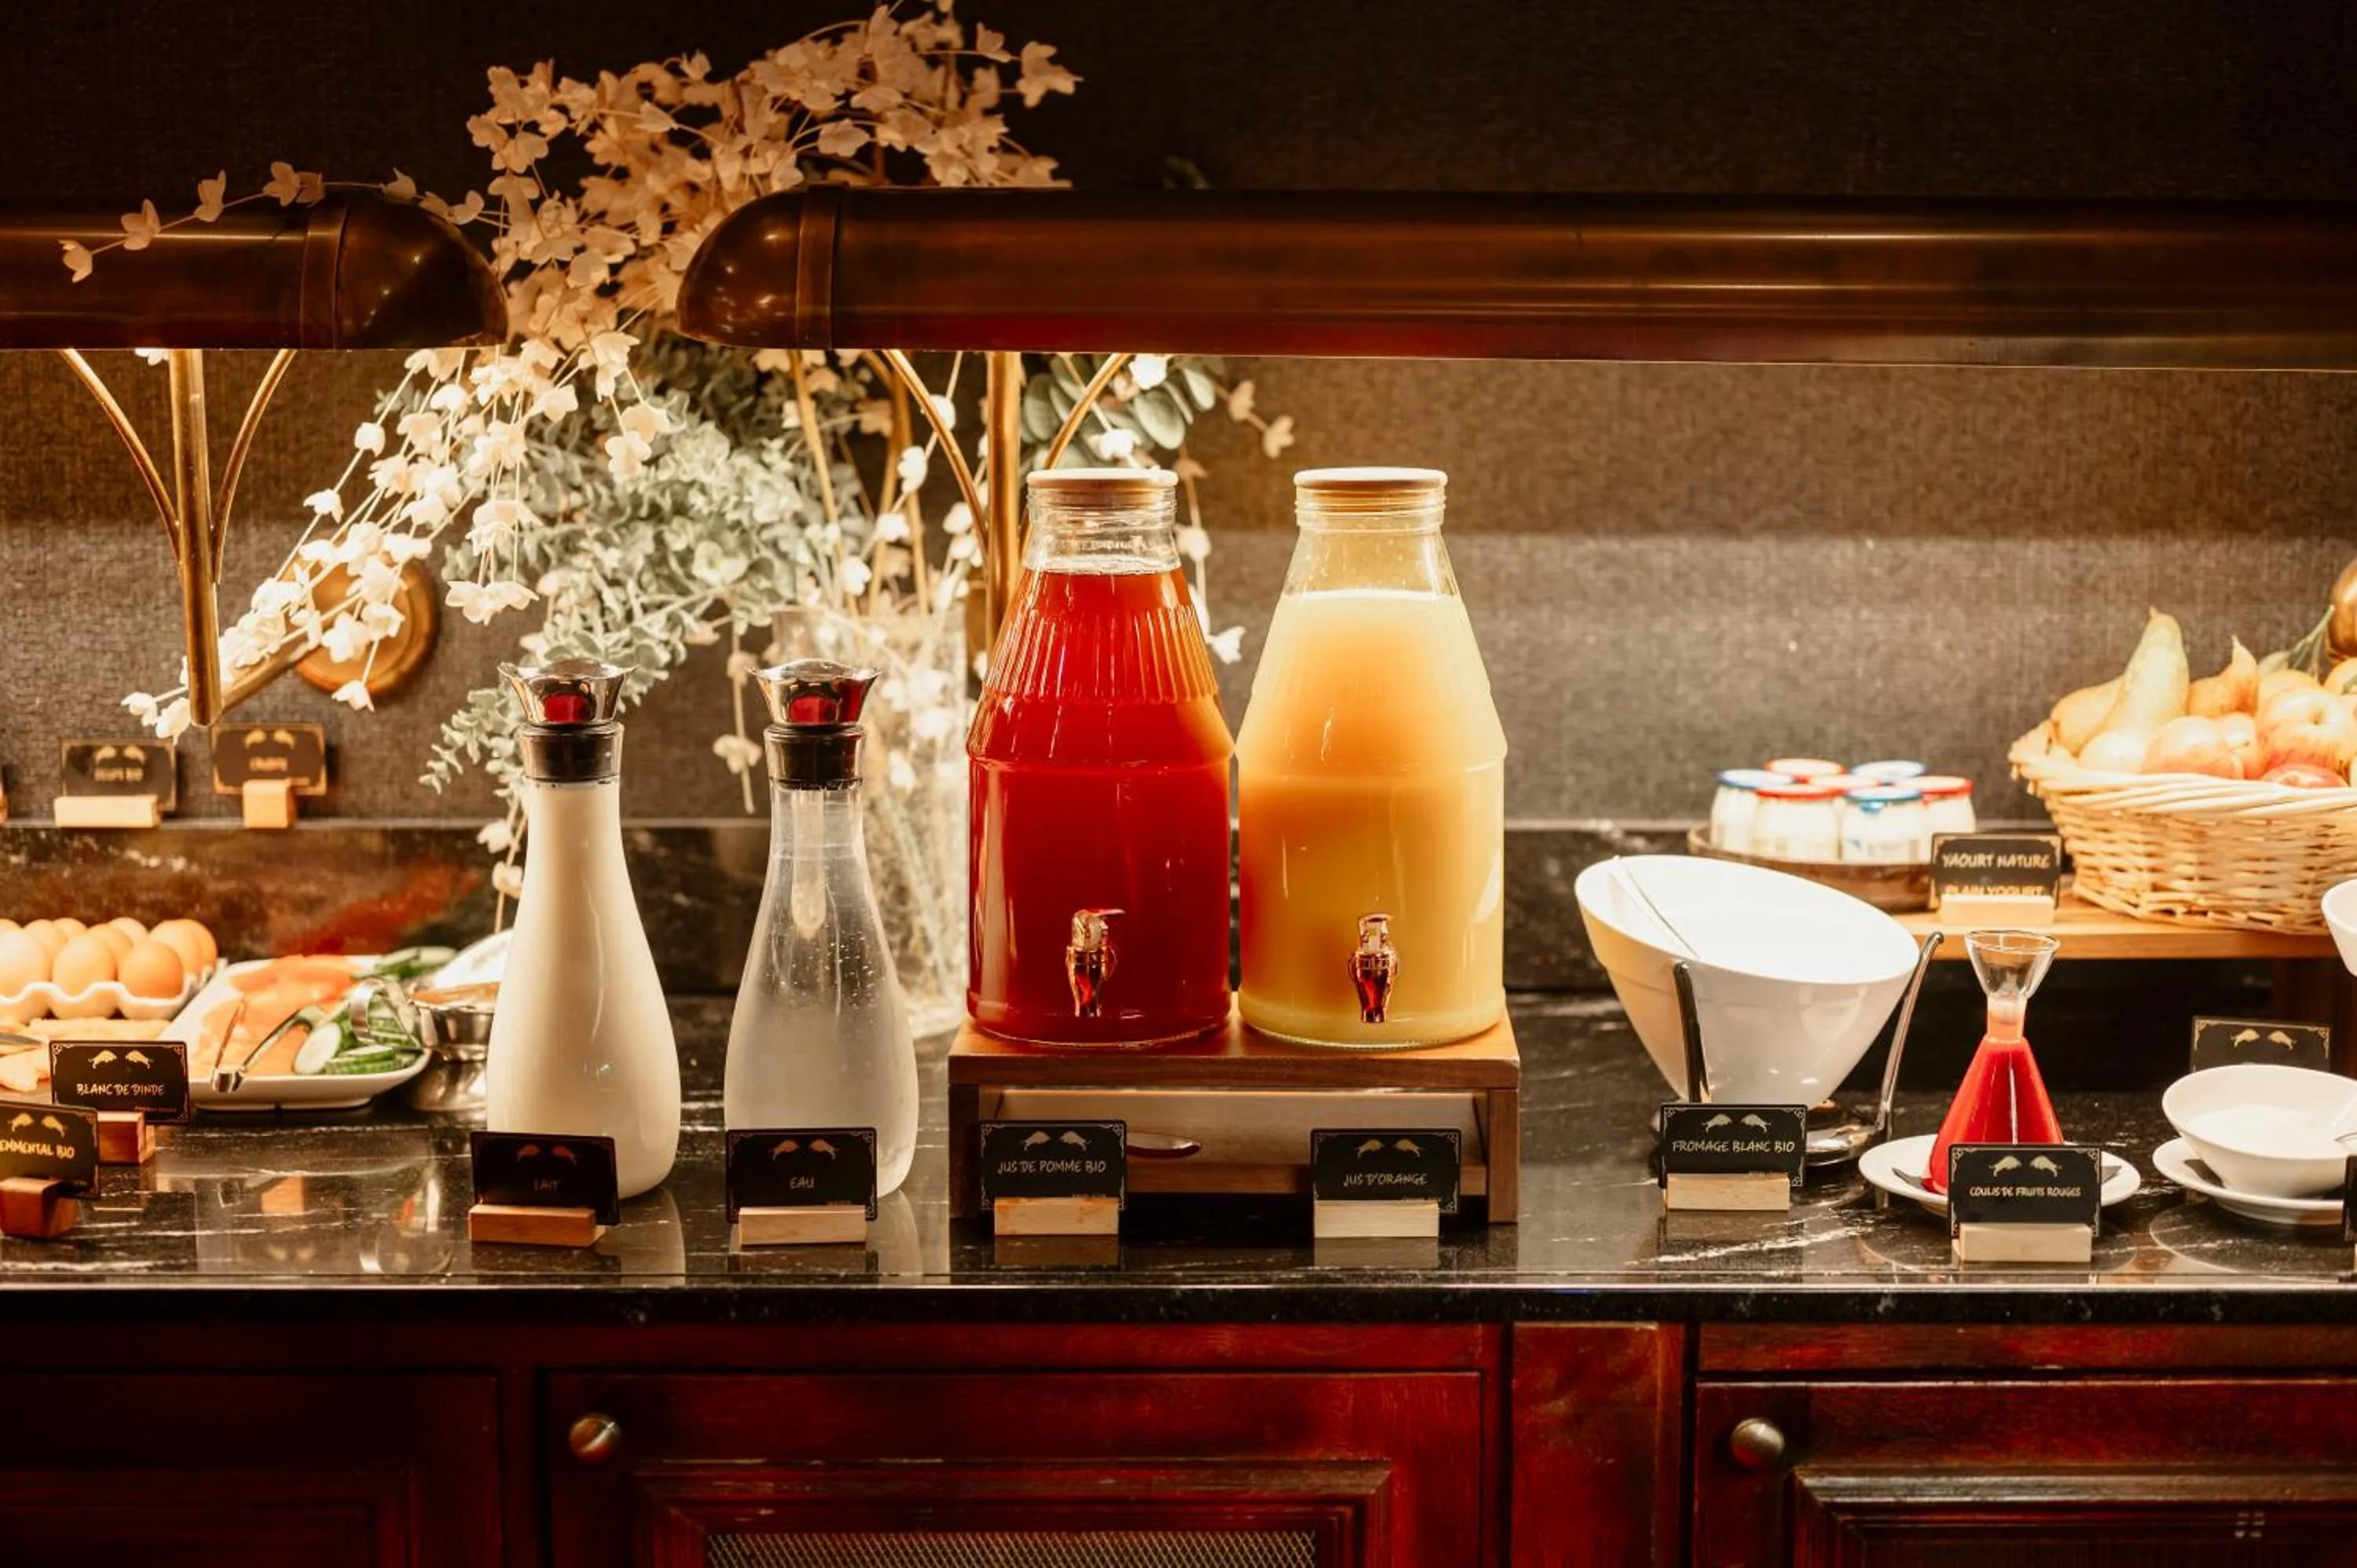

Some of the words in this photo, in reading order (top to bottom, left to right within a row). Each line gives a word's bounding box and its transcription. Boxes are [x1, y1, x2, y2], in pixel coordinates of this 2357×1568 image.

[1941, 852, 1996, 868] YAOURT
[1996, 854, 2051, 869] NATURE
[76, 1083, 114, 1096] BLANC
[115, 1084, 129, 1096] DE
[130, 1084, 165, 1096] DINDE
[57, 1145, 75, 1159] BIO
[1672, 1140, 1729, 1152] FROMAGE
[1732, 1141, 1771, 1152] BLANC
[1774, 1141, 1795, 1153] BIO
[997, 1161, 1018, 1174] JUS
[1019, 1161, 1036, 1173] DE
[1039, 1160, 1082, 1173] POMME
[1085, 1160, 1107, 1174] BIO
[790, 1177, 815, 1189] EAU
[1343, 1174, 1363, 1187] JUS
[1365, 1173, 1430, 1185] D'ORANGE
[1970, 1187, 2000, 1197] COULIS
[2000, 1187, 2014, 1196] DE
[2047, 1187, 2081, 1197] ROUGES
